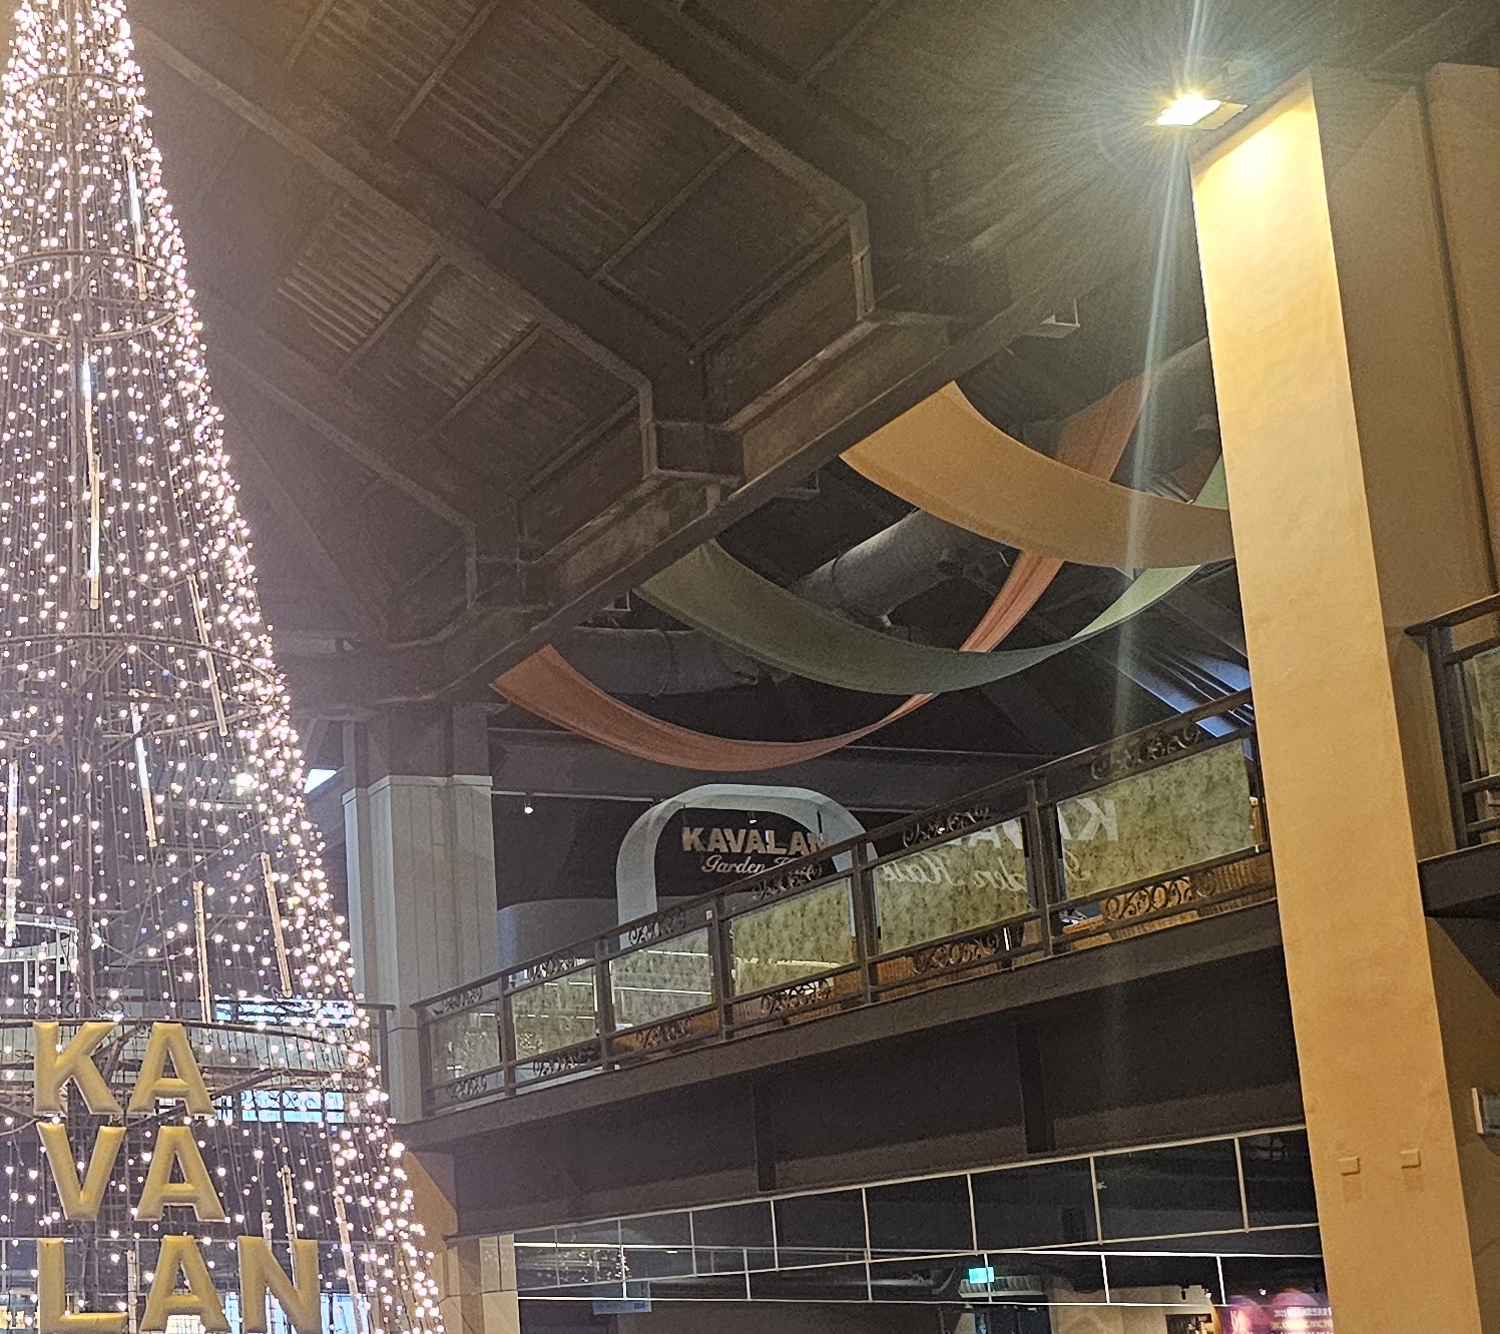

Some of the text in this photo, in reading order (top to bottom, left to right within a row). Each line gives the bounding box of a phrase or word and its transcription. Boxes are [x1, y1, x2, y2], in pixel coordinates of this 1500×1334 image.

[681, 826, 829, 857] KAVALAN
[33, 1022, 216, 1116] KA
[36, 1123, 227, 1222] VA
